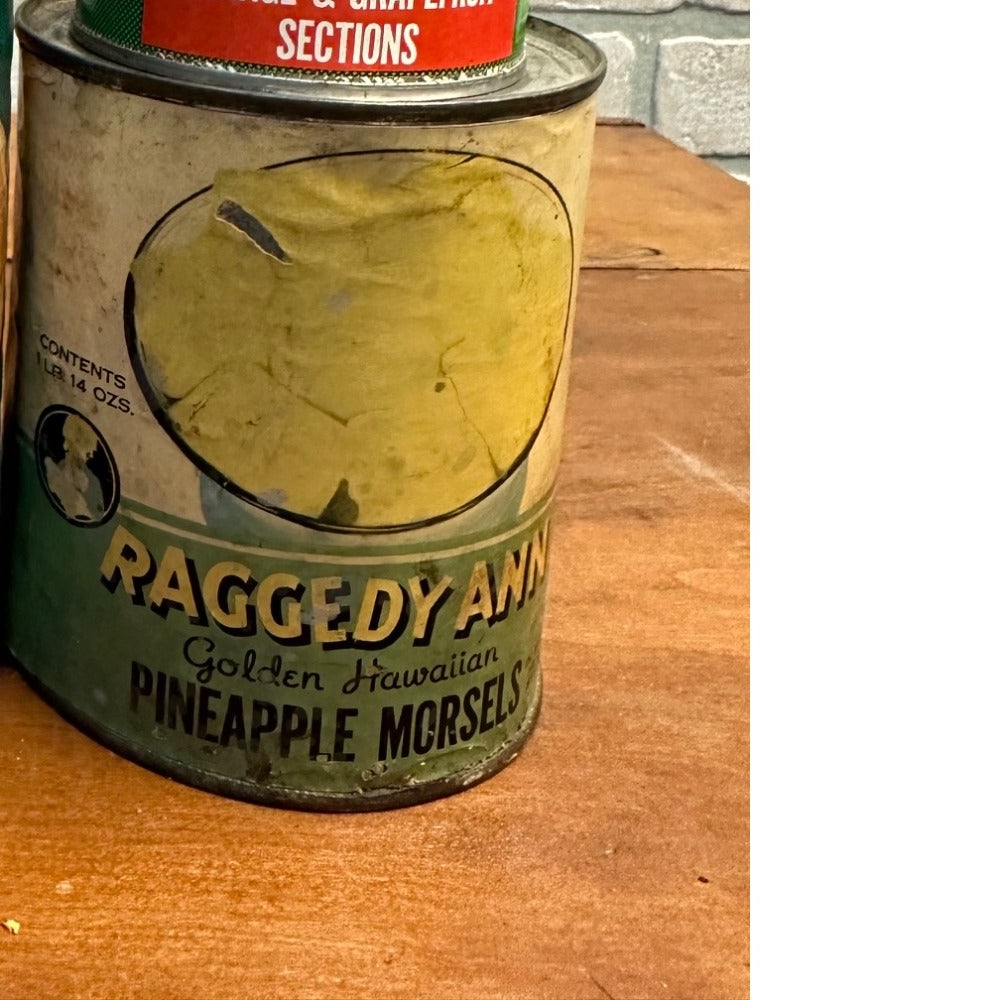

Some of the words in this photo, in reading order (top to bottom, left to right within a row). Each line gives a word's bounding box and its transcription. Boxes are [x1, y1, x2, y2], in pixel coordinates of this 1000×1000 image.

[275, 18, 420, 66] SECTIONS
[39, 333, 127, 390] CONTENTS
[70, 374, 87, 393] 14
[93, 386, 135, 416] OZS.
[101, 525, 454, 651] RAGGEDY
[454, 519, 550, 640] ANN
[182, 635, 325, 691] Golden
[341, 645, 500, 695] Hawaiian
[130, 660, 359, 762] PINEAPPLE
[377, 657, 523, 762] MORSELS
